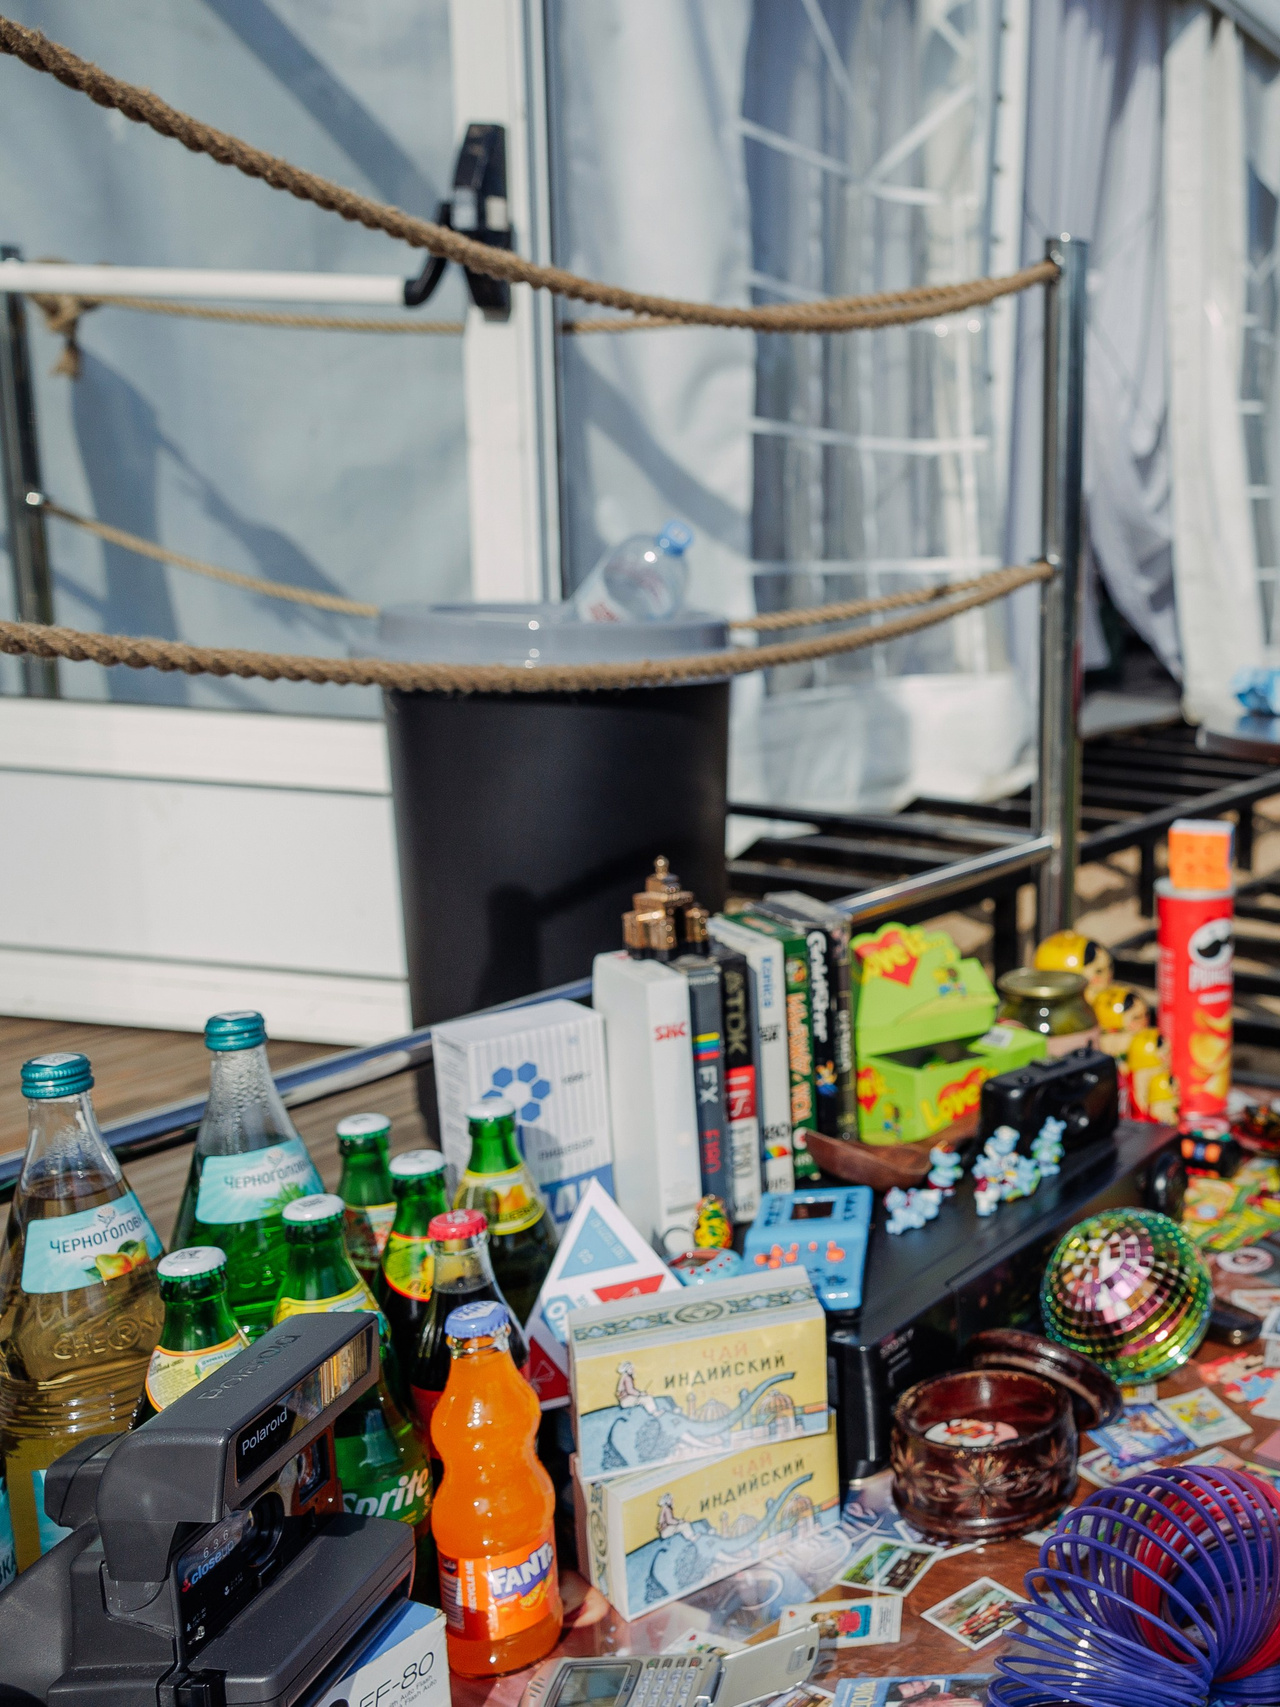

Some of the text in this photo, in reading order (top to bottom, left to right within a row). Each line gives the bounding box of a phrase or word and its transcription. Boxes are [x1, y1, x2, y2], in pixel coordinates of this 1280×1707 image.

[698, 1065, 720, 1104] FX
[664, 1350, 785, 1389] ИНДИЙСКИЙ
[242, 1406, 288, 1456] Polaroid
[699, 1453, 806, 1513] ИНДИЙСКИЙ
